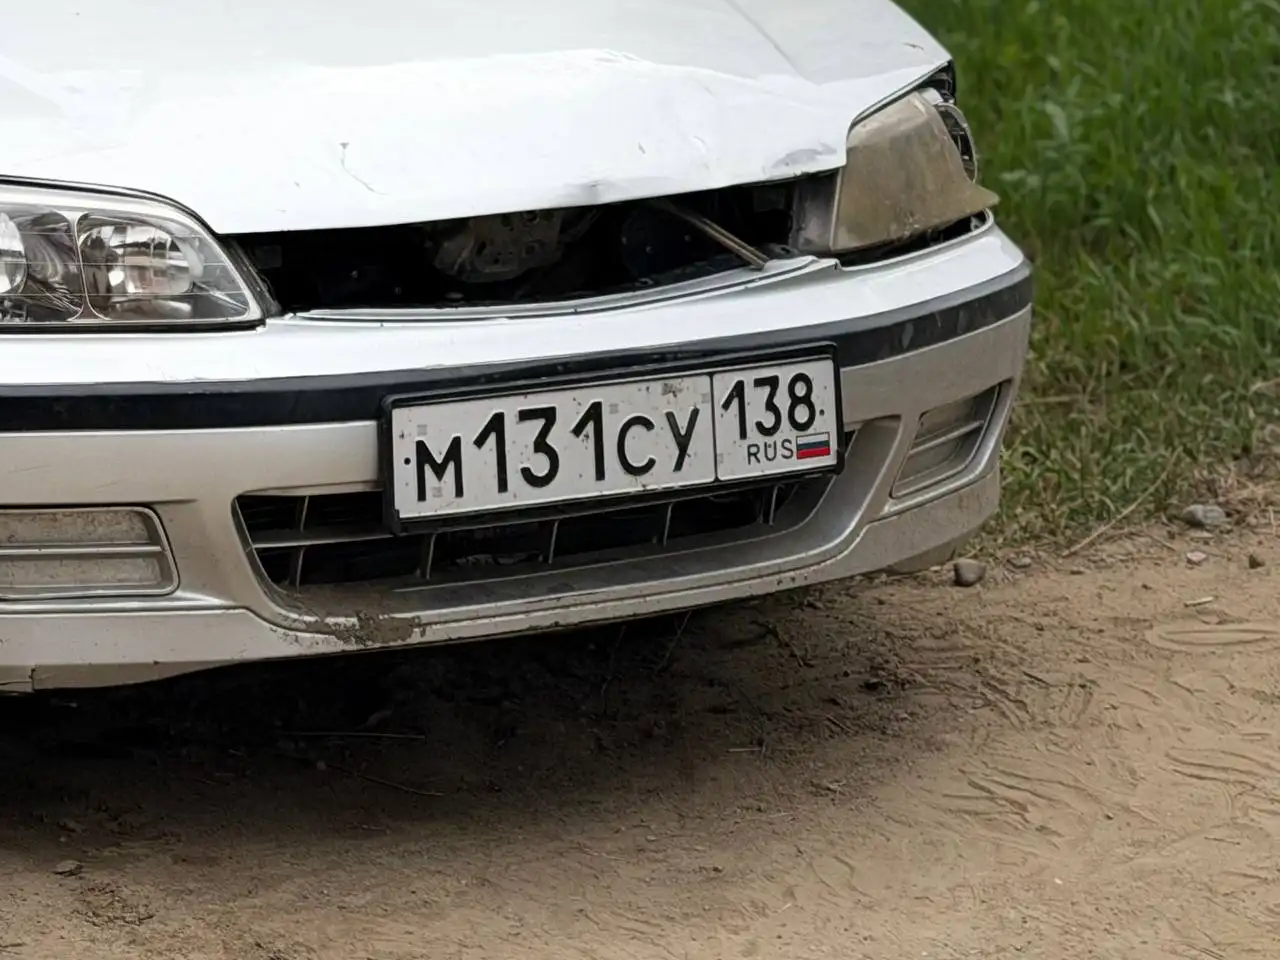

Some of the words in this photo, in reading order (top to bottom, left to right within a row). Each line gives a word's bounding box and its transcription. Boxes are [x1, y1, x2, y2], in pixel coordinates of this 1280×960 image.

[416, 399, 700, 502] М131СУ
[721, 372, 816, 440] 138
[746, 439, 794, 465] RUS
